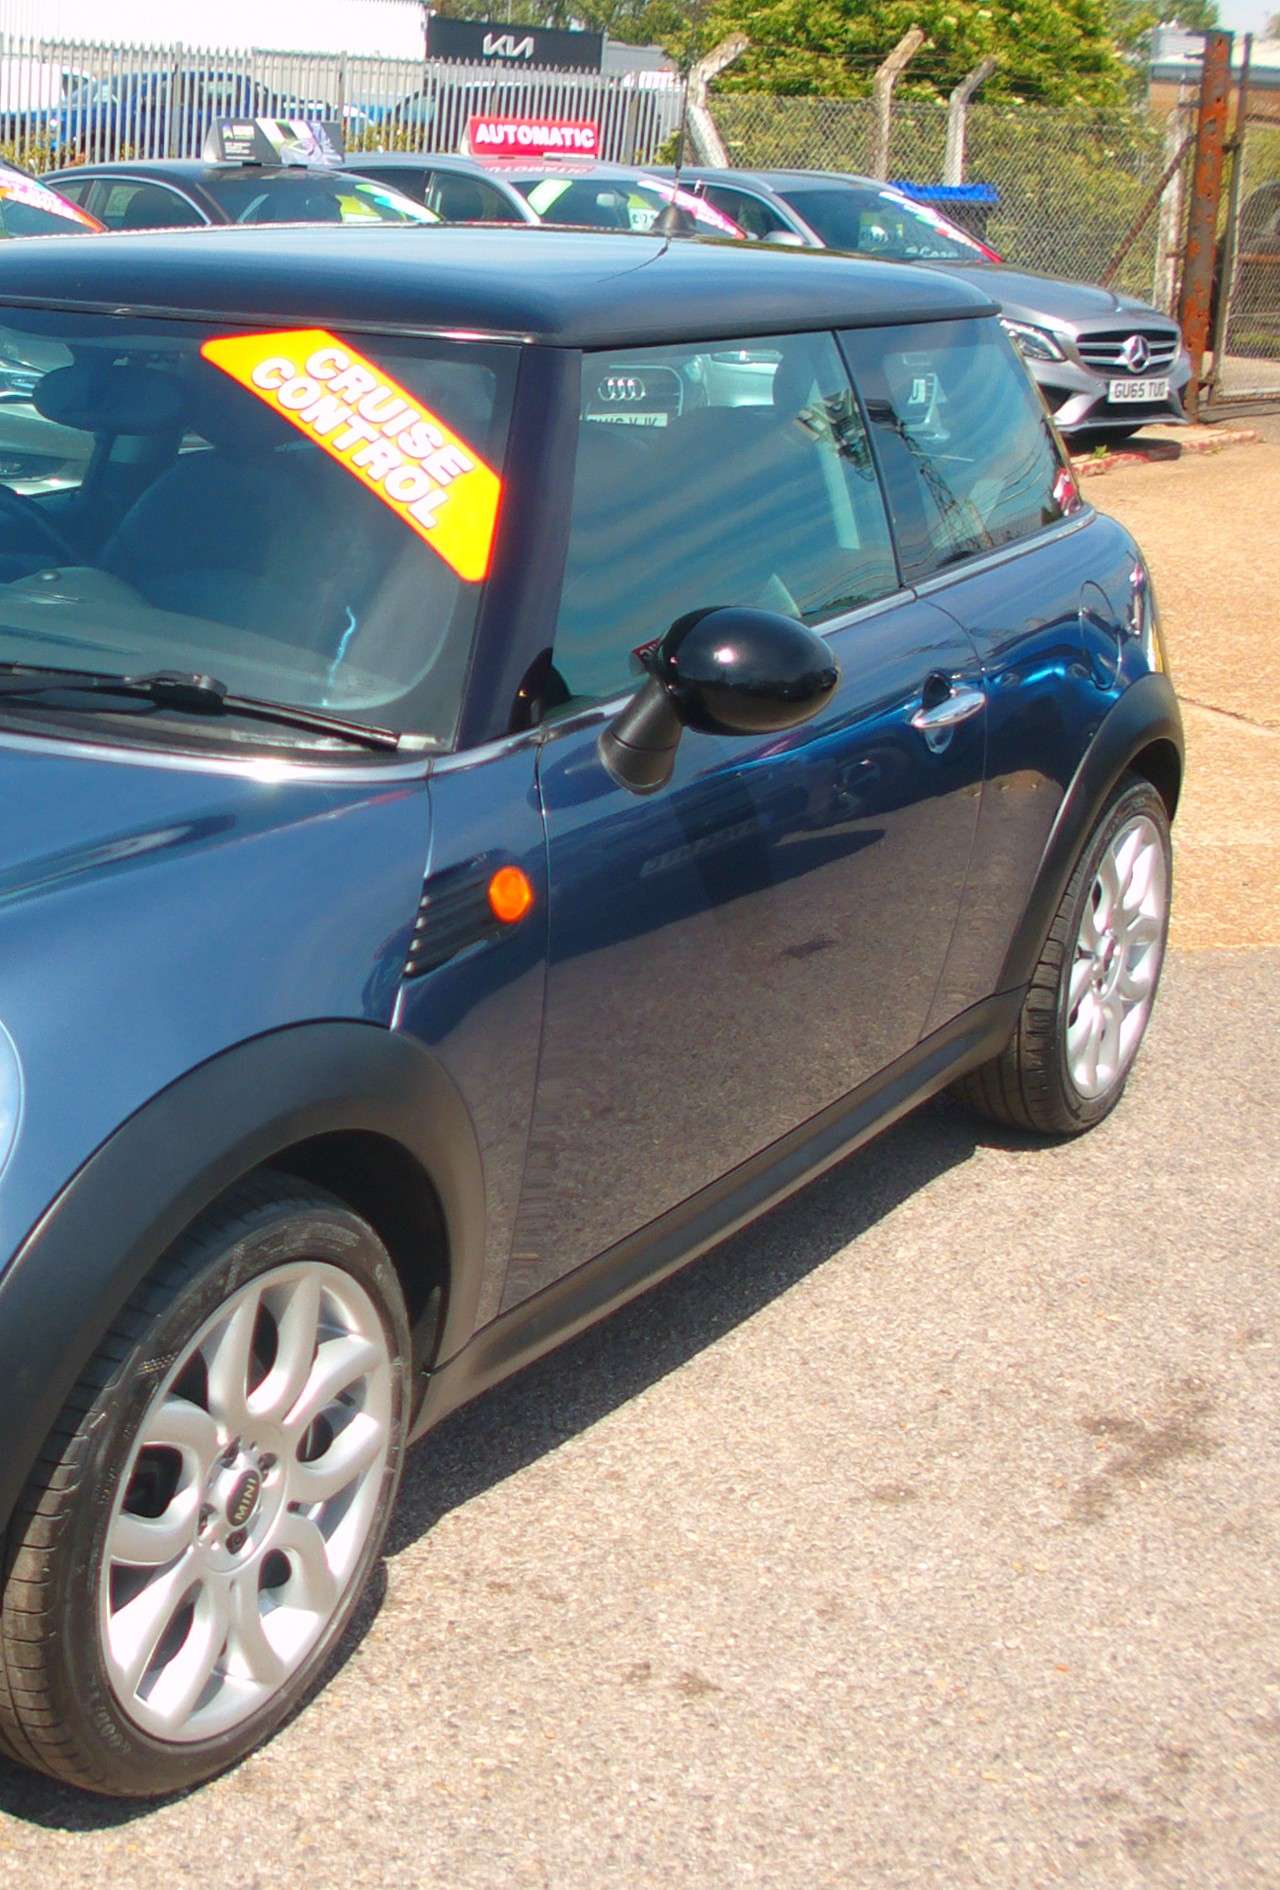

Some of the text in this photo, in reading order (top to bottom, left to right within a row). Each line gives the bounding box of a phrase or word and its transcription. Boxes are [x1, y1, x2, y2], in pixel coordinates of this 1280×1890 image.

[476, 123, 596, 148] AUTOMATIC
[251, 356, 449, 529] CONTROL
[305, 347, 474, 486] CRUISE
[235, 1478, 257, 1520] MINI
